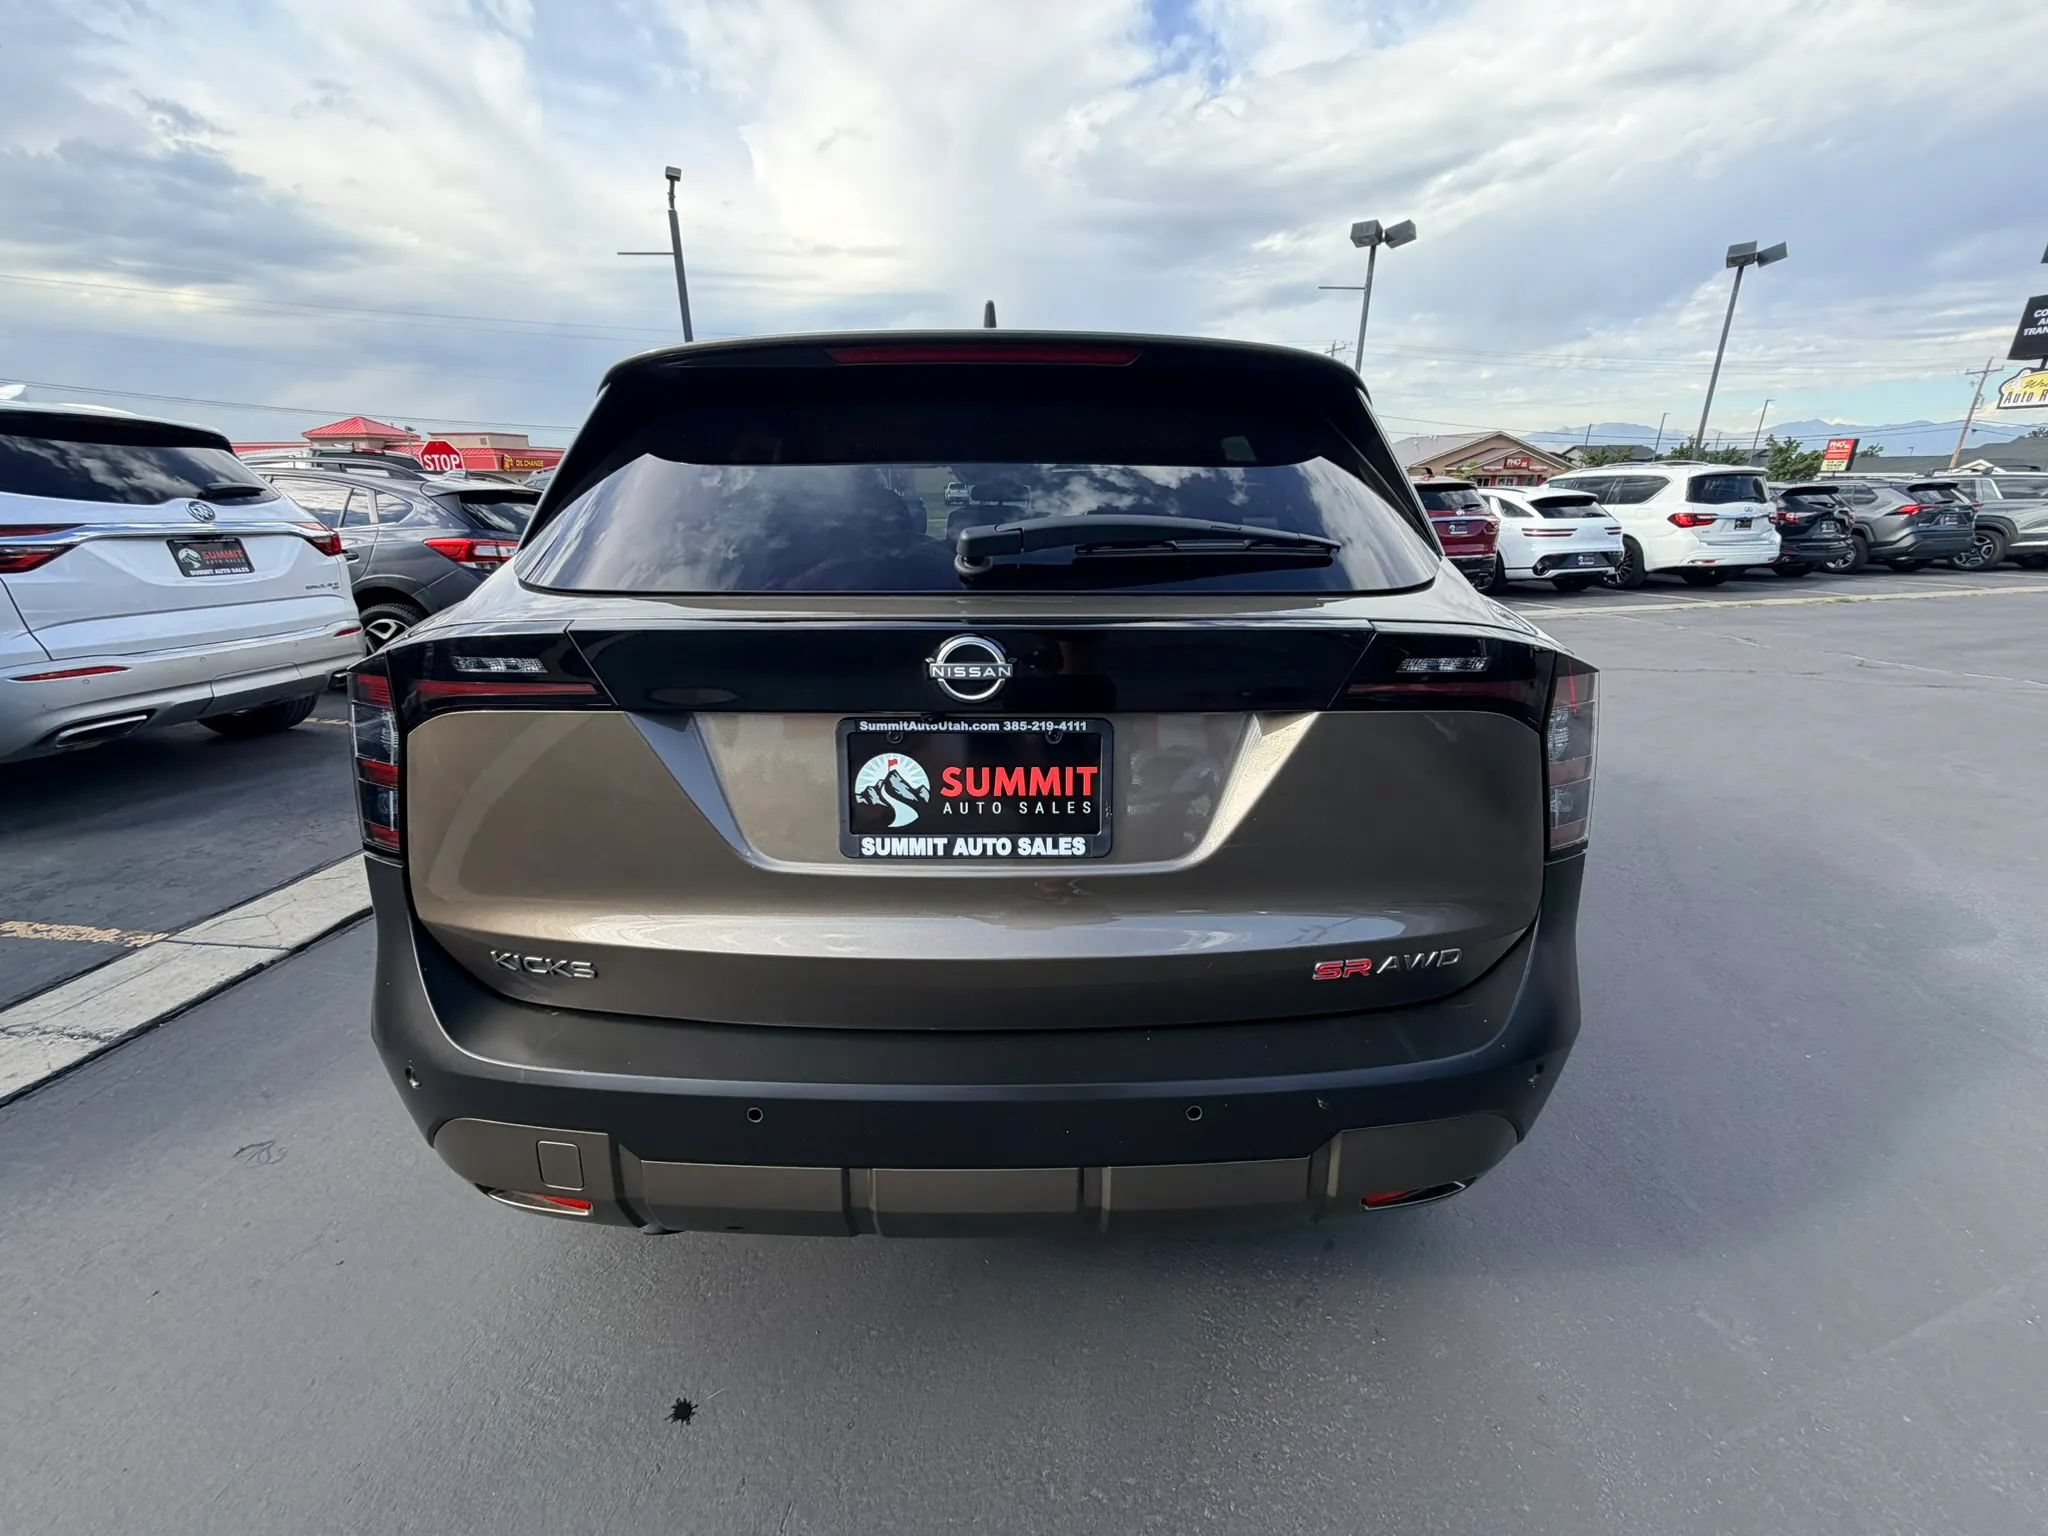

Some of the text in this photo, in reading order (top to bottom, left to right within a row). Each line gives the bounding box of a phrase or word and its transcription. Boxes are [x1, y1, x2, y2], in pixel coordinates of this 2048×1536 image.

[2004, 391, 2034, 404] Auto
[423, 454, 460, 471] STOP
[202, 550, 243, 560] SUMMIT
[931, 666, 1012, 677] NISSAN
[859, 721, 1087, 732] SummitAutoUtah.com 385-219-4111
[940, 766, 1098, 798] SUMMIT
[943, 802, 1091, 815] AUTO SALES
[861, 837, 1086, 856] SUMMIT AUTO SALES
[490, 950, 599, 979] KICKS
[1312, 948, 1462, 980] SR AWD
